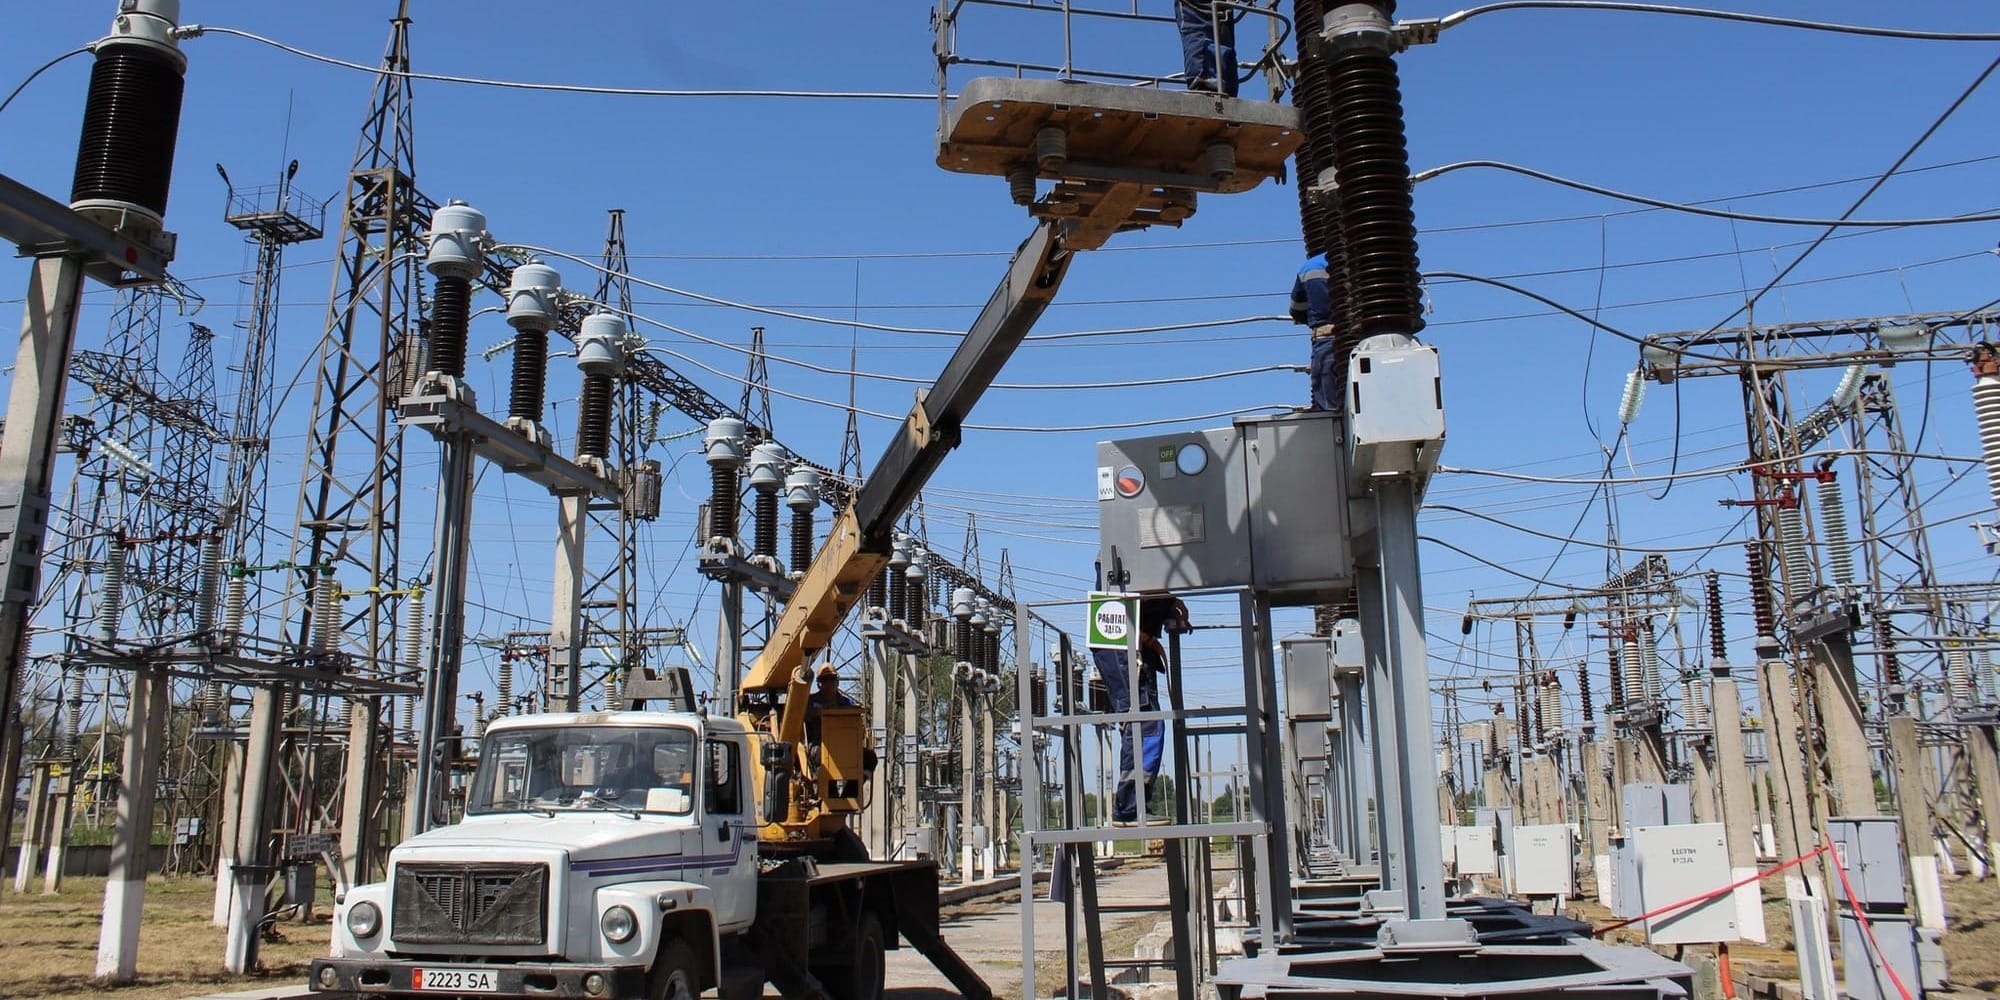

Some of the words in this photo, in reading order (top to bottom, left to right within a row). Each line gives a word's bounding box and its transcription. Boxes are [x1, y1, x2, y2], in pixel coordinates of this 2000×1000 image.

[1161, 450, 1174, 460] OFF
[1097, 613, 1127, 625] РАБОТАТ
[1104, 624, 1122, 634] ЗДЕСЬ
[428, 972, 462, 988] 2223
[468, 973, 490, 989] SA
